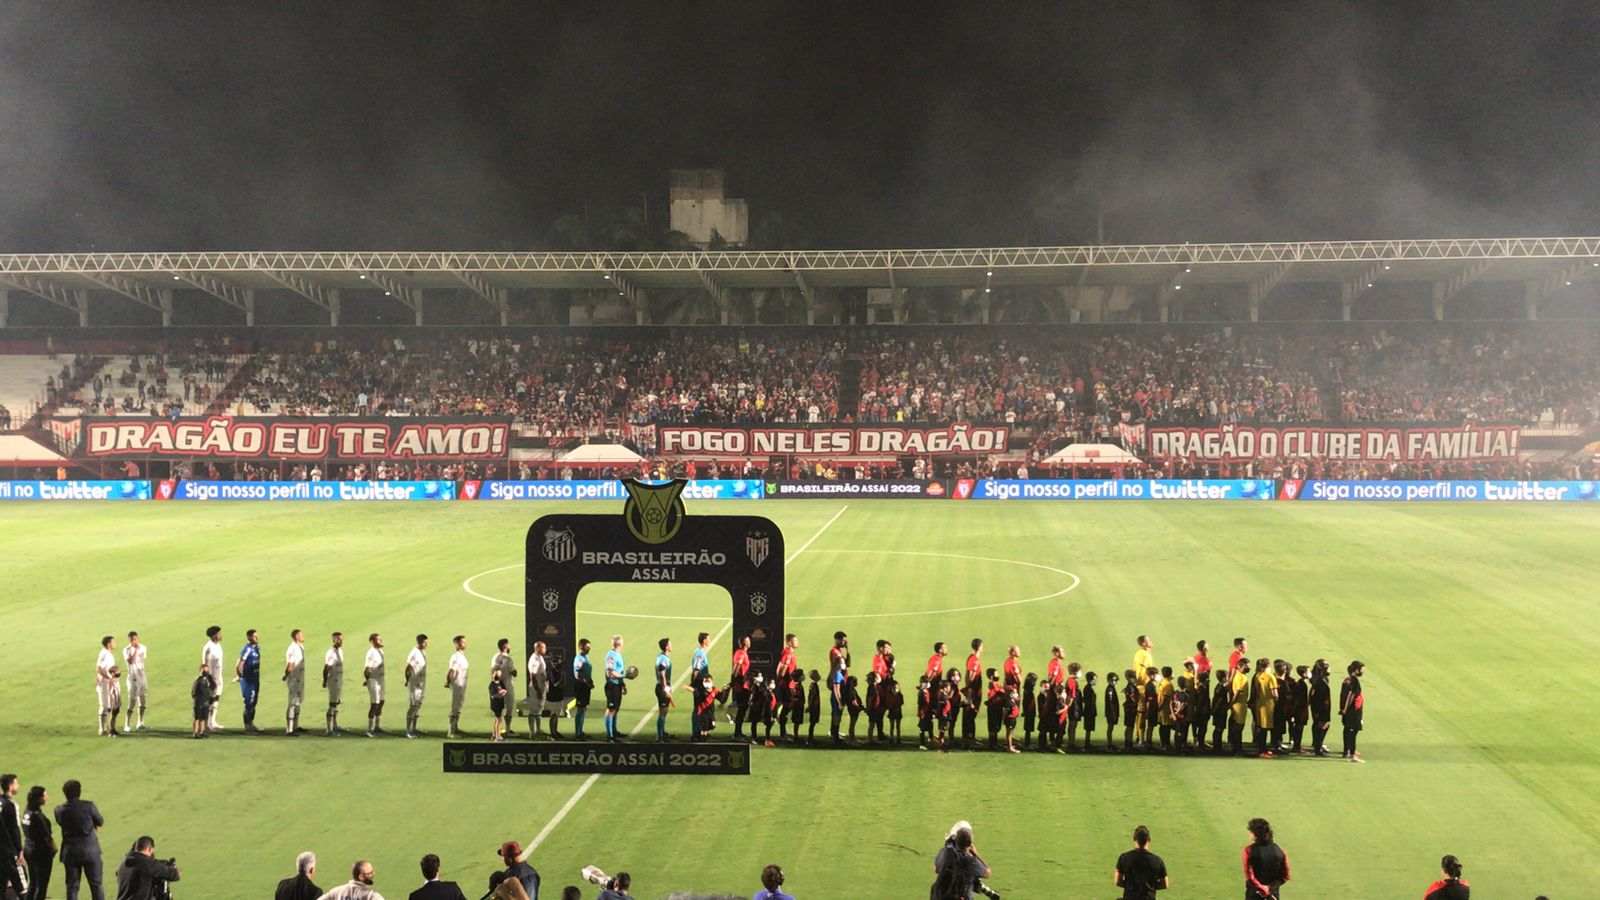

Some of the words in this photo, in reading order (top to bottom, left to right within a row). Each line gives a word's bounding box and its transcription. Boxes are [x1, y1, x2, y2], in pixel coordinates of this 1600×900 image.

[91, 419, 263, 452] DRAGÃO
[273, 428, 326, 454] EU
[338, 428, 386, 454] TE
[394, 427, 505, 455] AMO!
[663, 430, 745, 452] FOGO
[753, 431, 850, 452] NELES
[859, 424, 1006, 451] DRAGÃO!
[1151, 424, 1255, 459] DRAGÃO
[1259, 431, 1278, 458] O
[1283, 431, 1361, 459] CLUBE
[1367, 432, 1400, 459] DA
[1407, 425, 1518, 460] FAMÍLIA!
[15, 485, 34, 497] no
[39, 480, 112, 499] twitter
[185, 482, 218, 499] Siga
[222, 485, 265, 498] nosso
[269, 482, 310, 499] perfil
[315, 485, 334, 497] no
[339, 481, 415, 499] twitter
[490, 482, 523, 499] Siga
[527, 485, 572, 498] nosso
[577, 482, 617, 499] perfil
[780, 484, 860, 494] BRASILEIRÃO
[891, 485, 921, 493] 2022
[984, 481, 1018, 499] Siga
[1023, 485, 1069, 498] nosso
[1074, 481, 1118, 499] perfil
[1123, 484, 1143, 497] no
[1150, 481, 1231, 499] twitter
[1312, 482, 1349, 499] Siga
[1353, 486, 1402, 498] nosso
[1406, 482, 1450, 499] perfil
[1455, 485, 1477, 498] no
[1484, 481, 1568, 499] twitter
[582, 549, 726, 565] BRASILEIRÃO
[472, 751, 612, 766] BRASILEIRÃO
[670, 754, 722, 766] 2022
